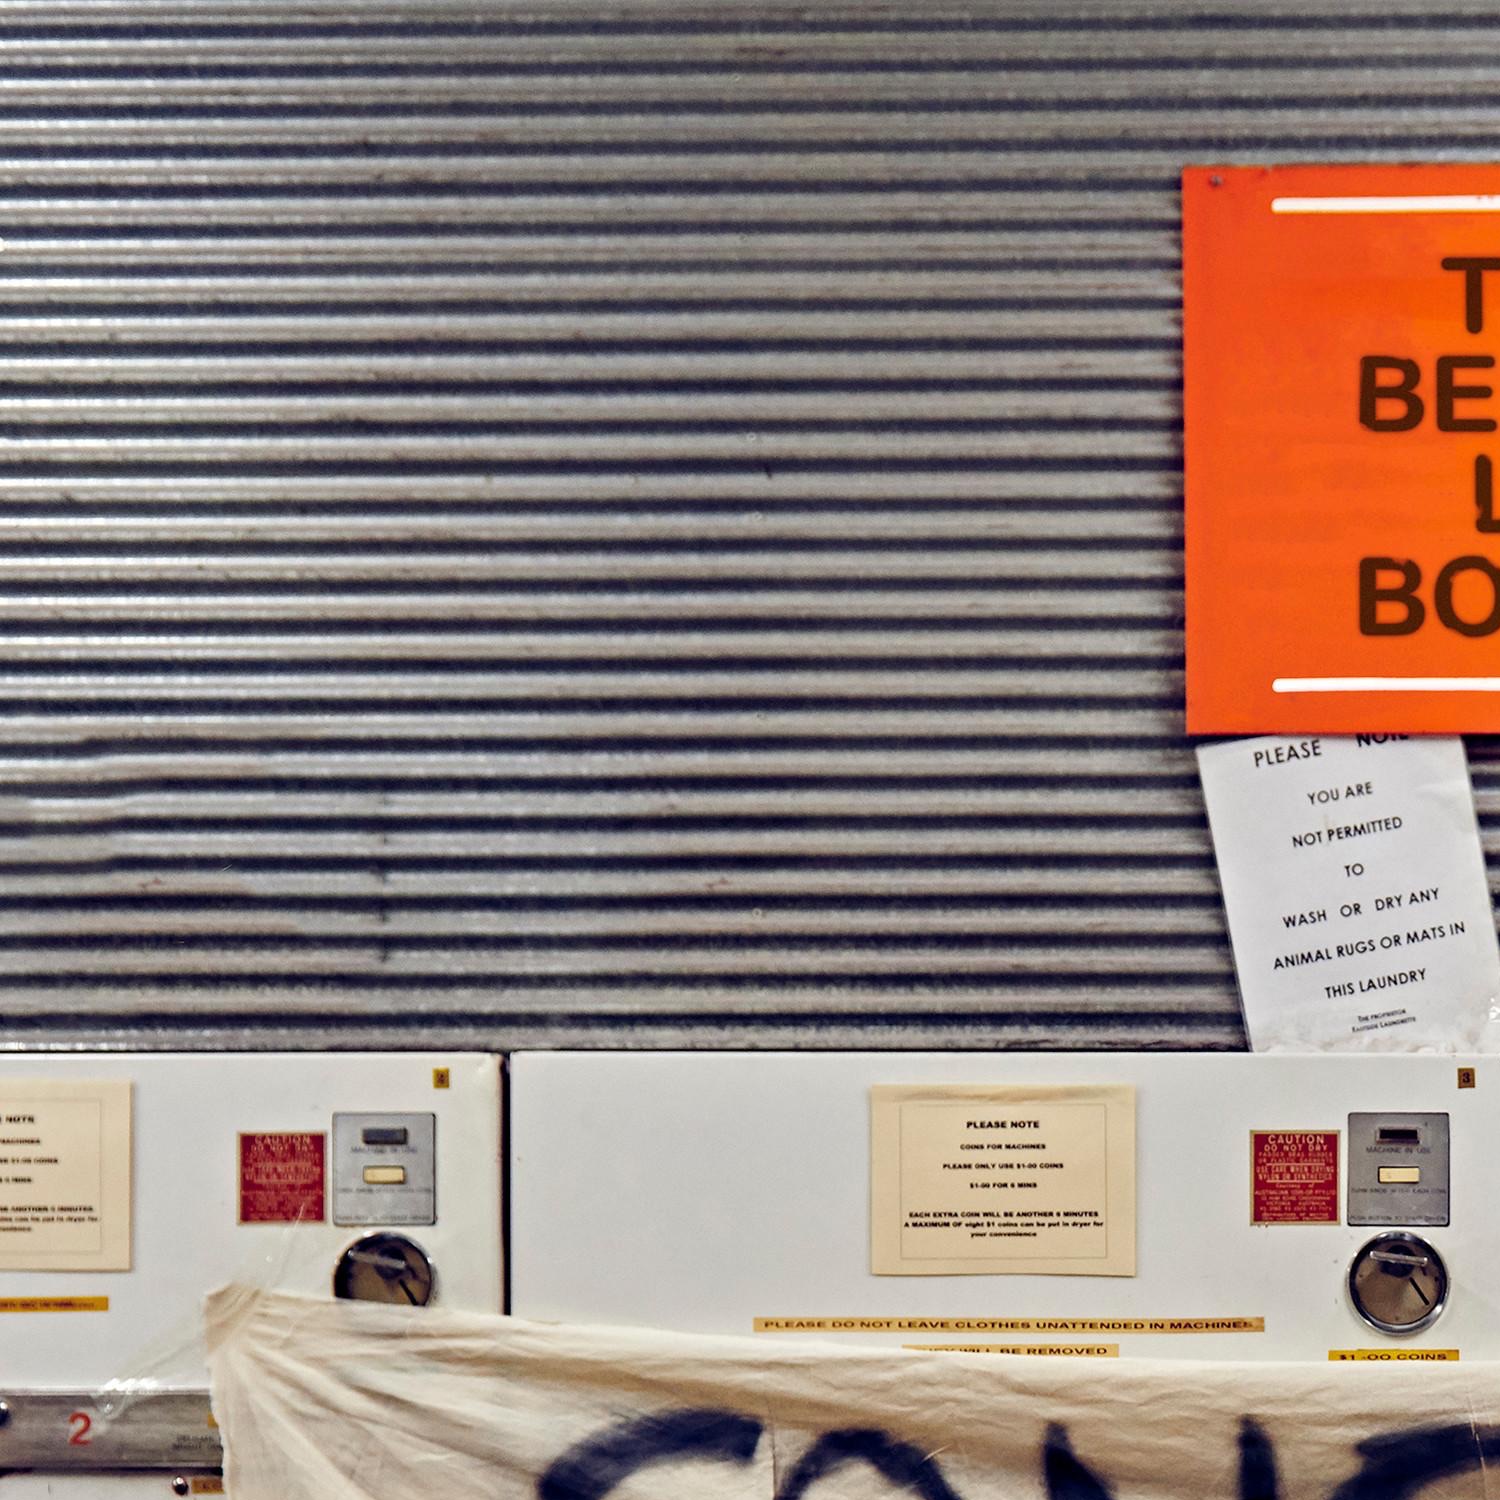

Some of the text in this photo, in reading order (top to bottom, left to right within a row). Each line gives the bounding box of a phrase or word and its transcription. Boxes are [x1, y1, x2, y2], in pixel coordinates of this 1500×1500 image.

[1254, 739, 1322, 767] PLEASE
[1308, 782, 1373, 805] YOU ARE
[1292, 816, 1402, 847] NOT PERMITTED
[1344, 863, 1364, 877] TO
[1283, 888, 1439, 928] WASH OR DRY ANY
[1274, 921, 1465, 970] ANIMAL RUGS OR MATS IN
[1325, 968, 1426, 999] THIS LAUNDRY
[1462, 1072, 1470, 1083] 3
[967, 1121, 1006, 1129] PLEASE
[1268, 1135, 1324, 1144] CAUTION
[764, 1321, 826, 1329] PLEASE
[832, 1321, 855, 1329] DO
[898, 1321, 950, 1329] LEAVE
[954, 1321, 1031, 1329] CLOTHES
[1036, 1321, 1144, 1329] UNATTENDED
[69, 1412, 92, 1446] 2
